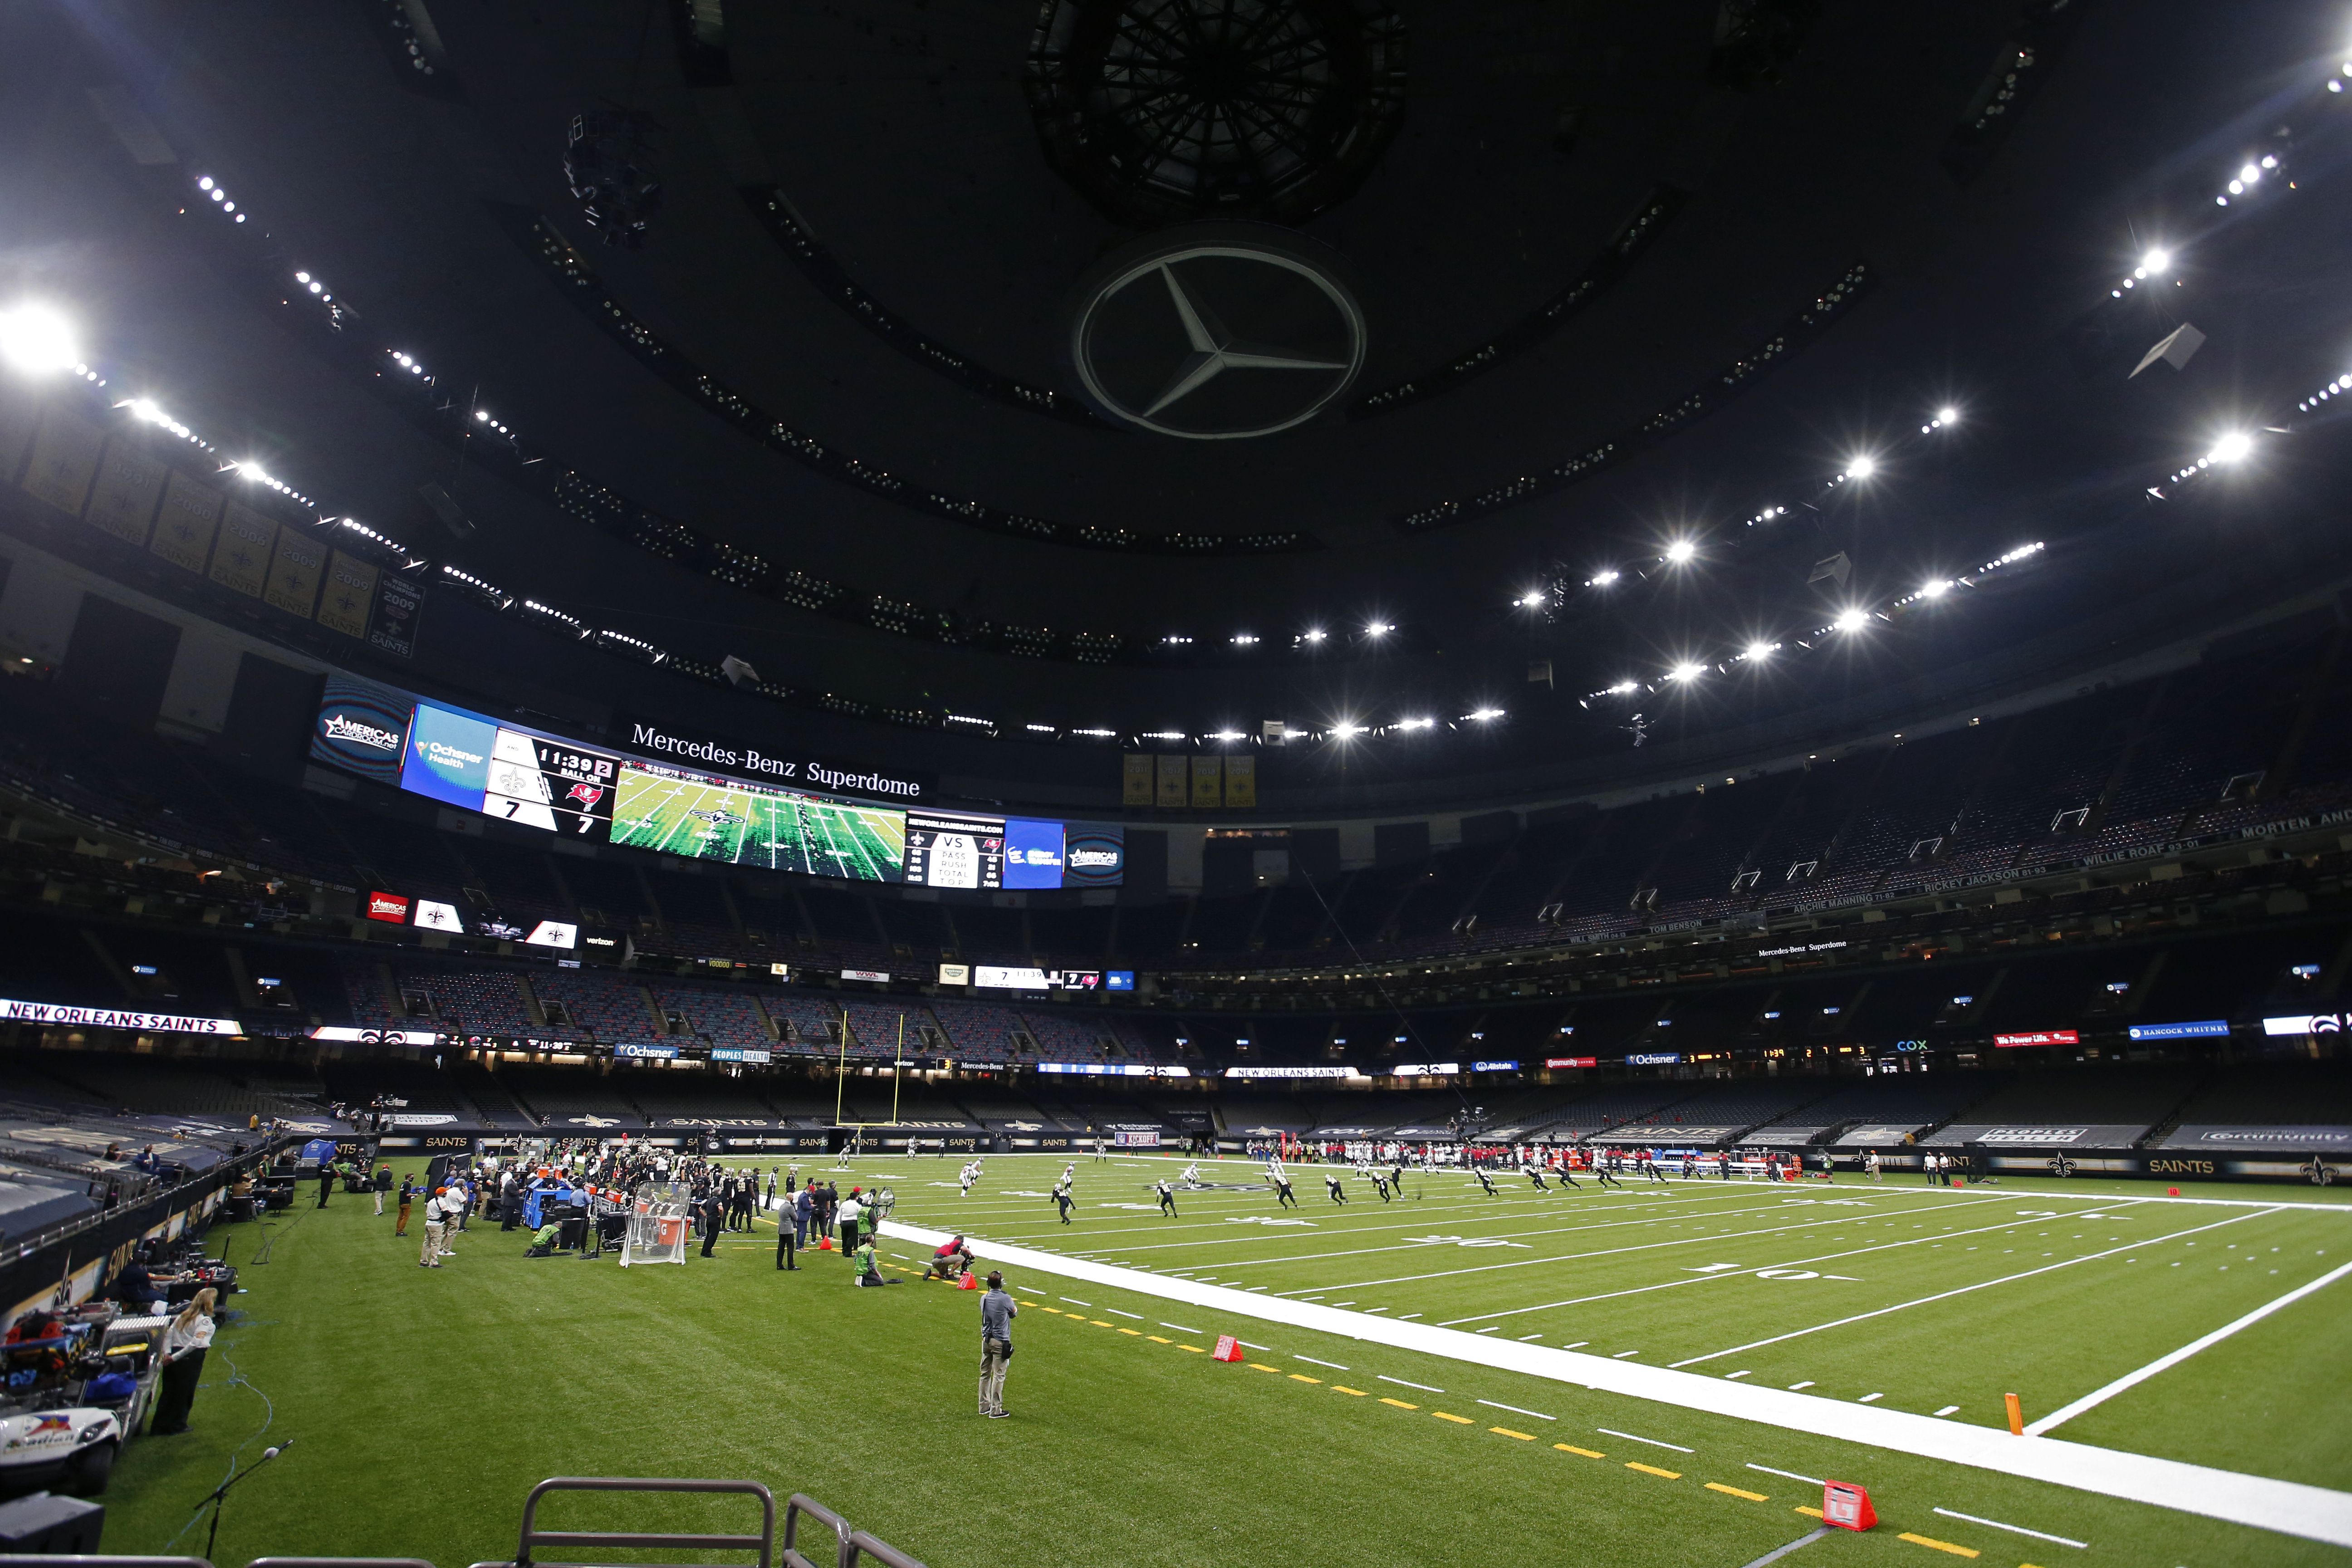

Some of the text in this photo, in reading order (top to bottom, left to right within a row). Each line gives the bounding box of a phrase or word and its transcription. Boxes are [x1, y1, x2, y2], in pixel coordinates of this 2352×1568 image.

[230, 523, 266, 547] 2006
[282, 548, 317, 569] 2009
[334, 570, 369, 591] 2009
[391, 578, 415, 591] WORLD
[383, 580, 421, 600] CHAMPIONS
[267, 593, 309, 616] SAINTS
[383, 591, 415, 610] 2009
[320, 614, 361, 636] SAINTS
[371, 635, 409, 655] SAINTS
[333, 714, 399, 744] AMERICAS
[335, 727, 397, 750] CARDROOM.net
[430, 742, 483, 764] Ochsner
[429, 753, 463, 769] Health
[540, 749, 607, 774] 11:39 2
[631, 724, 920, 796] Mercedes-Benz Superdome
[561, 768, 601, 783] BALL ON
[506, 801, 520, 818] 7
[578, 816, 593, 833] 7
[908, 818, 1003, 833] NEWORLEANSSAINTS.COM
[2242, 818, 2310, 838] MORTEN
[944, 837, 962, 848] VS
[943, 851, 965, 859] PASS
[1073, 848, 1117, 860] AMERICAS
[2083, 840, 2199, 867] WILLIE ROAF 93-01
[247, 862, 260, 871] NOLA
[1925, 867, 2047, 892] RICKEY JACKSON 81-93
[333, 884, 356, 894] LOCATION
[375, 898, 407, 911] AMERICAS
[1793, 892, 1895, 913] ARCHIE MANNING 71-82
[1649, 920, 1702, 933] TOM BENSON
[587, 937, 614, 946] verizon
[1570, 936, 1587, 944] WILL
[1588, 932, 1610, 942] SMITH
[1759, 941, 1846, 956] Mercedes-Benz Superdome
[709, 960, 730, 968] VOODOO
[1069, 974, 1078, 984] 7
[8, 1002, 218, 1032] NEW ORLEANS SAINTS
[2185, 1025, 2228, 1033] WHITNEY
[2033, 1034, 2049, 1042] Life.
[539, 1041, 563, 1049] 11:39
[627, 1045, 672, 1058] Ochsner
[1897, 1040, 1928, 1051] COX
[713, 1050, 741, 1059] PEOPLES
[1636, 1055, 1675, 1064] Ochsner
[1764, 1049, 1784, 1058] 11:39
[1806, 1049, 1812, 1057] 2
[945, 1059, 950, 1069] 3
[961, 1062, 1004, 1070] Mercedes-Benz
[1487, 1062, 1512, 1070] Allstate
[1548, 1059, 1577, 1068] Community
[426, 1137, 466, 1147] SAINTS
[1128, 1135, 1154, 1143] KICKOFF
[2151, 1160, 2213, 1174] SAINTS
[662, 1224, 667, 1235] G
[1830, 1486, 1855, 1524] G
